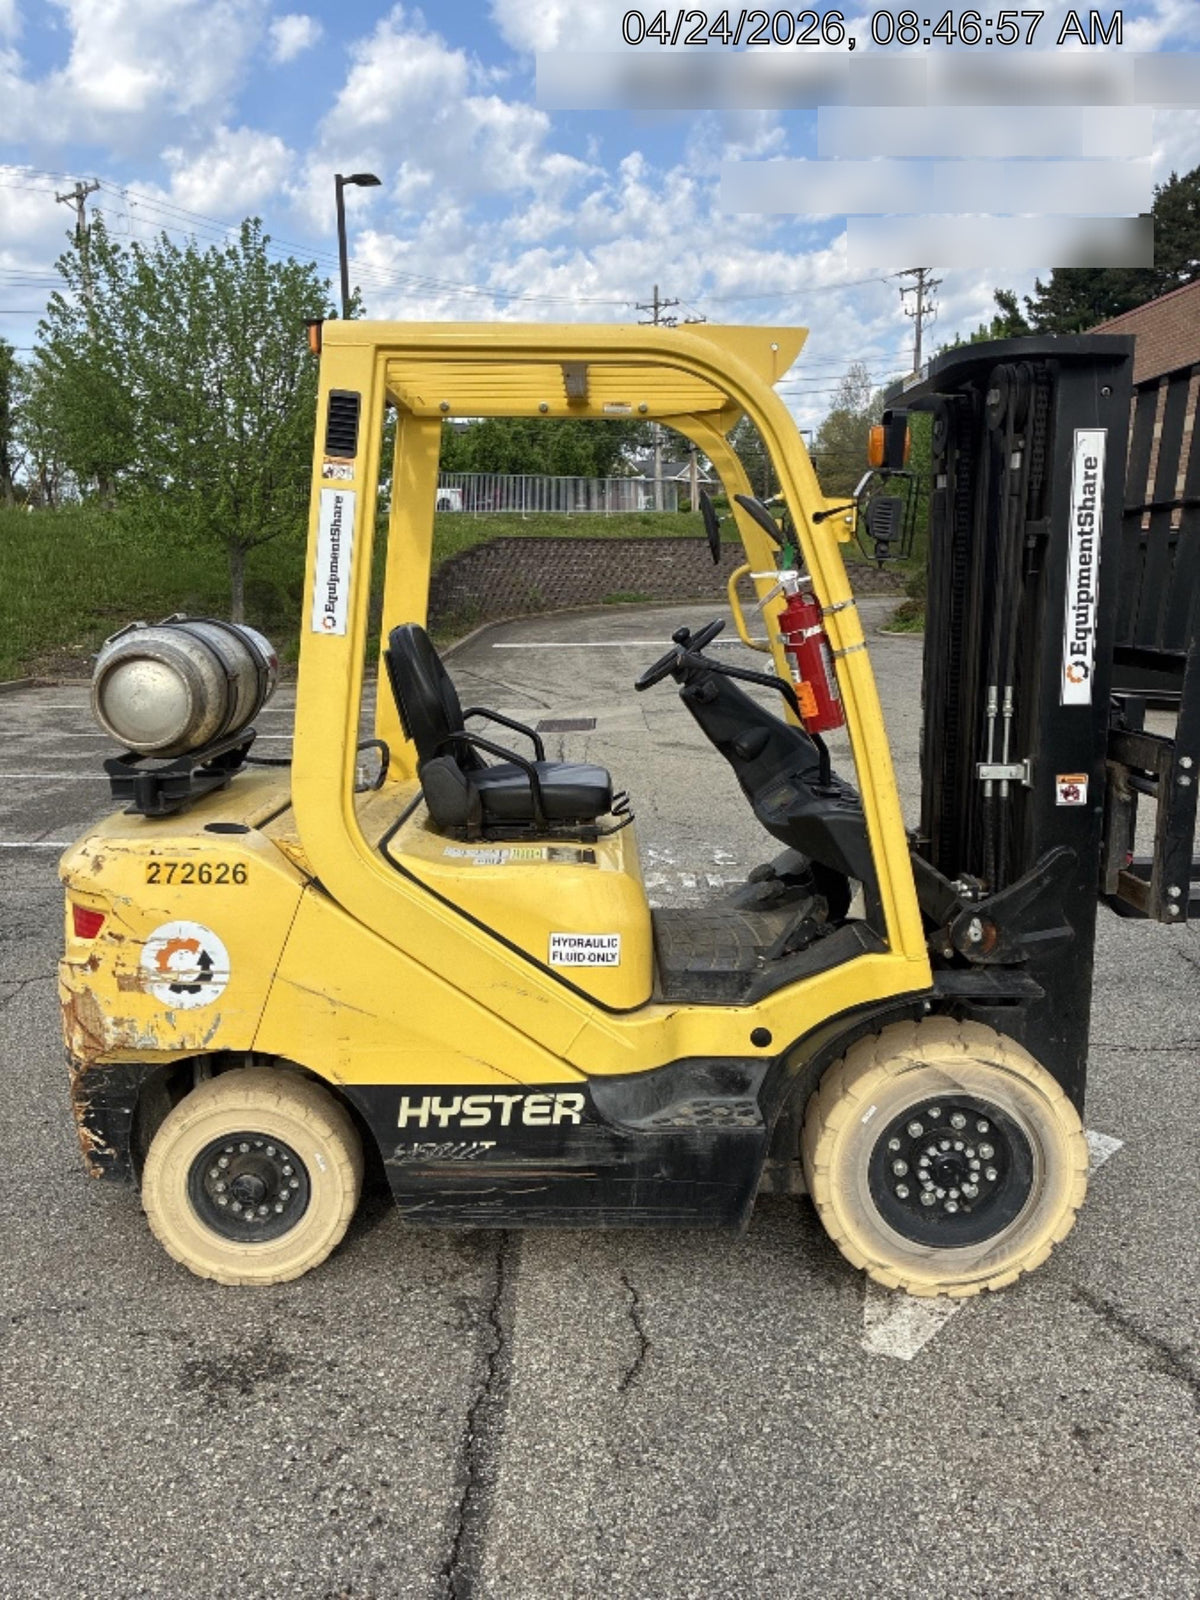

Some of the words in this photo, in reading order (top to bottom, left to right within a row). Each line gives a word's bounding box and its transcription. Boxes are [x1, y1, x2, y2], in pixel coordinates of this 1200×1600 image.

[323, 495, 344, 614] EquipmentShare
[1070, 456, 1099, 657] EquipmentShare
[147, 862, 247, 884] 272626
[552, 936, 618, 949] HYDRAULIC
[552, 950, 586, 963] FLUID
[587, 952, 617, 963] ONLY
[397, 1092, 585, 1128] HYSTER
